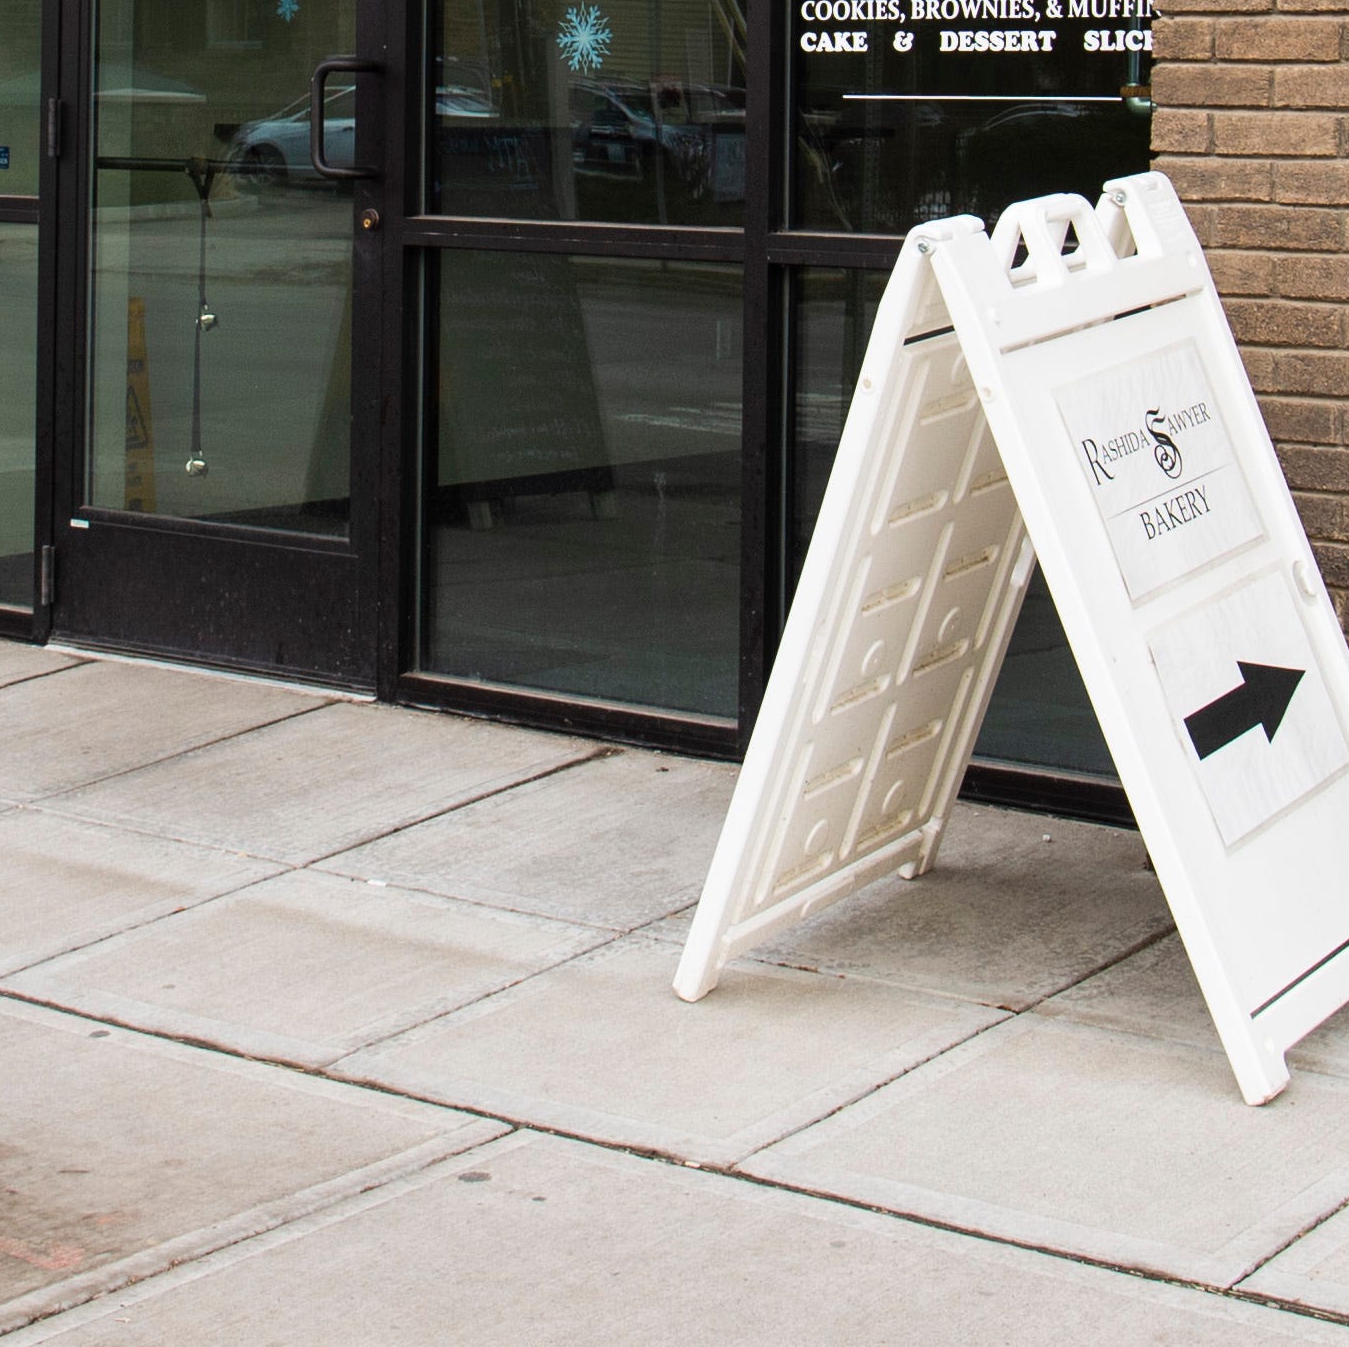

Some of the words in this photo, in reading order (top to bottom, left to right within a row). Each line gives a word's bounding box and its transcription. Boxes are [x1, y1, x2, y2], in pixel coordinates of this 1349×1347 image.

[800, 31, 868, 54] CAKE
[893, 31, 914, 52] &
[940, 30, 1057, 53] DESSERT
[1082, 429, 1150, 485] RASHIDA
[1145, 402, 1211, 479] SAWYER
[1140, 485, 1211, 540] BAKERY
